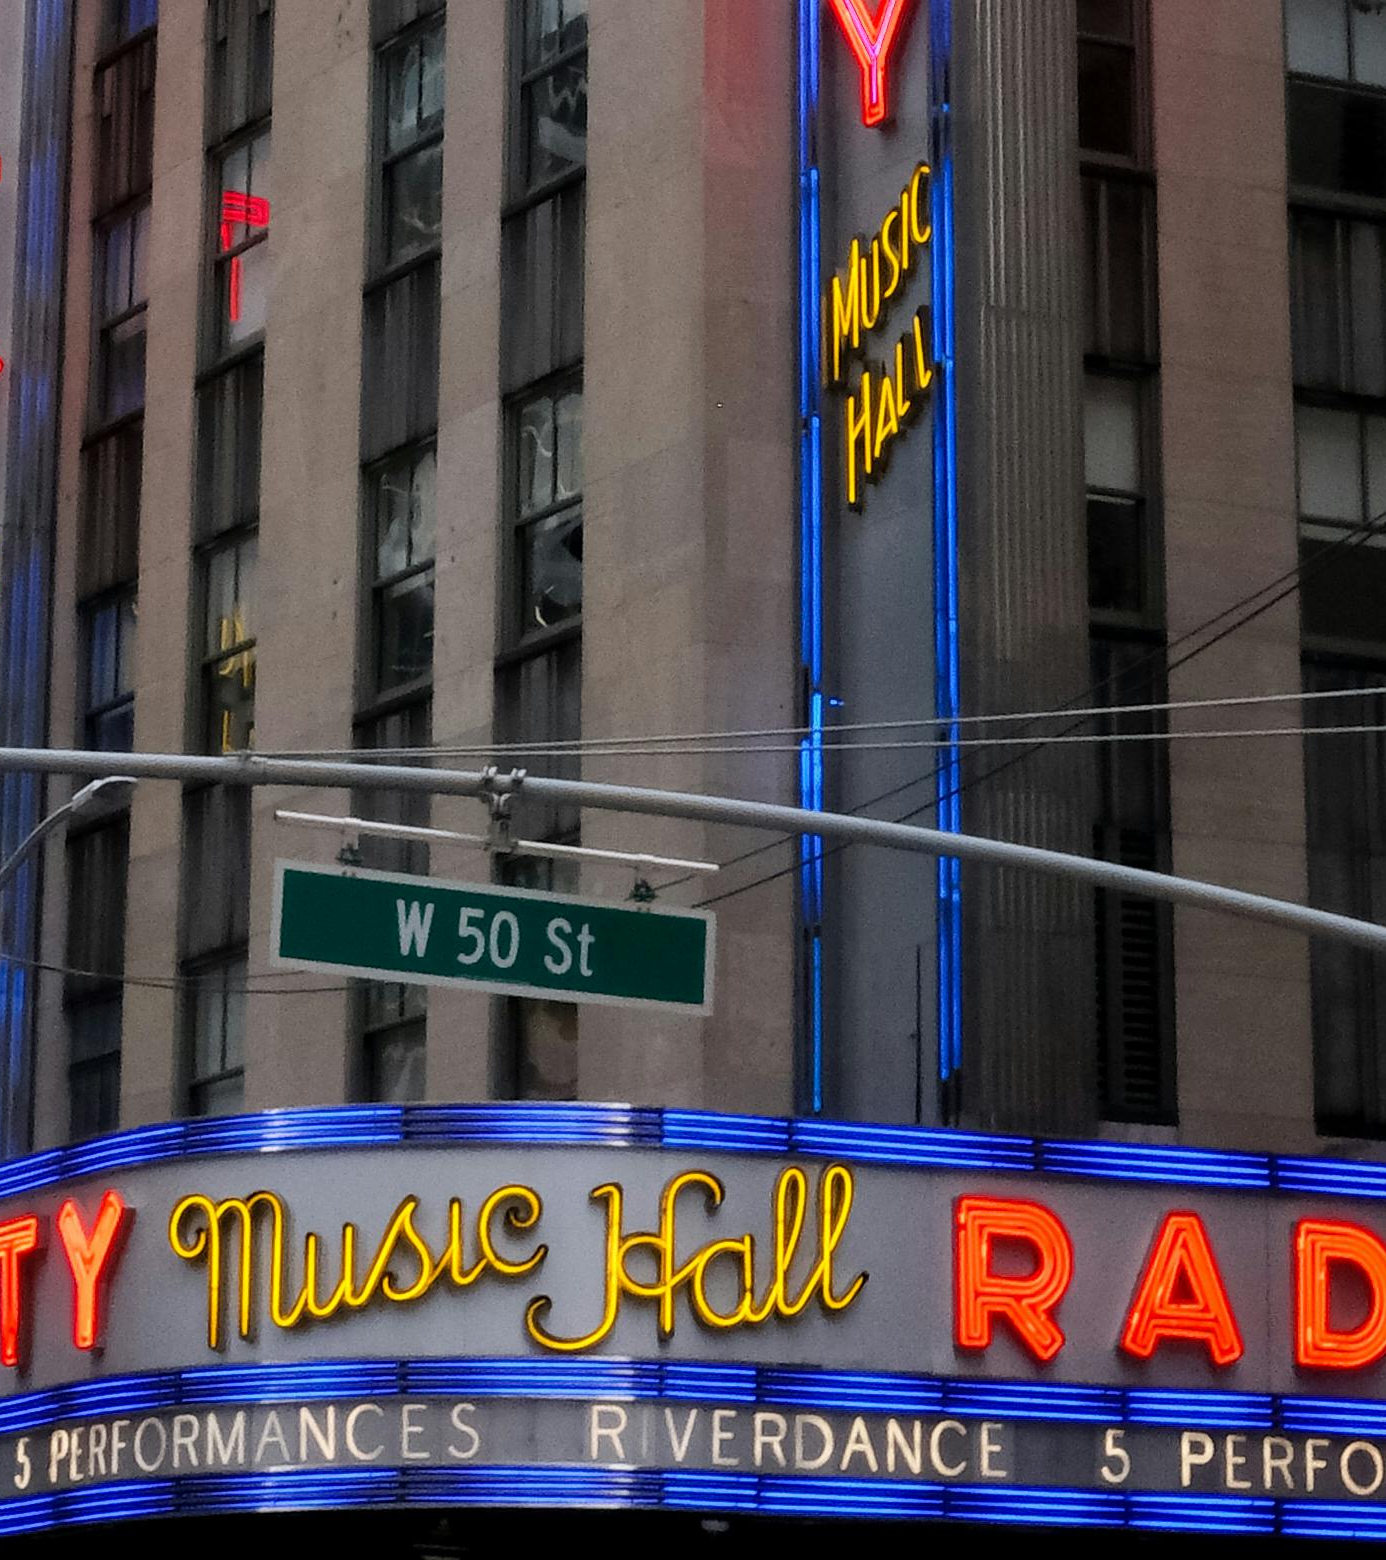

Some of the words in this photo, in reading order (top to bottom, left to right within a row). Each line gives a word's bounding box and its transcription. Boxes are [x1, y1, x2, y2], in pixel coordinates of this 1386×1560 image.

[830, 164, 932, 382] MUSIC
[845, 314, 932, 504] HALL
[396, 898, 435, 958] W
[456, 906, 519, 969] 50
[543, 917, 596, 977] St
[167, 1182, 548, 1351] Music
[525, 1162, 870, 1355] Hall
[14, 1437, 31, 1490] 5
[48, 1403, 481, 1484] PERFORMANCES
[591, 1404, 1008, 1479] RIVERDANCE
[1101, 1429, 1132, 1484] 5
